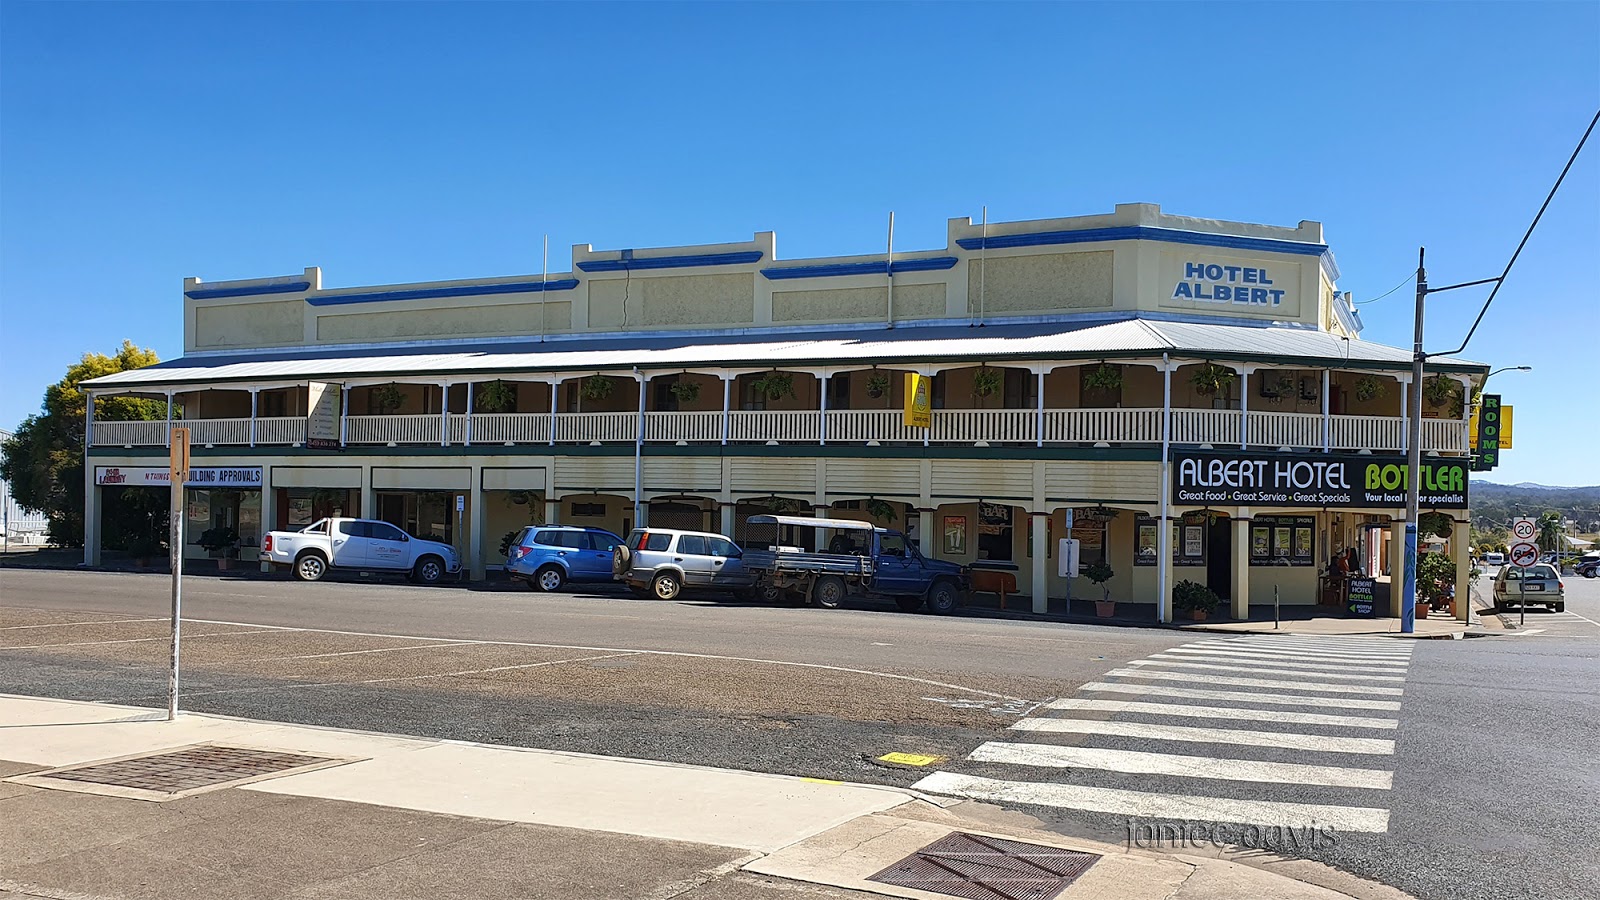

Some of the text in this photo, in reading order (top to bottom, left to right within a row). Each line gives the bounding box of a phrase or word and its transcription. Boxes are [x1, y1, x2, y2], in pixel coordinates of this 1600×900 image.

[1184, 262, 1273, 286] HOTEL
[1171, 281, 1285, 307] ALBERT
[1483, 398, 1498, 464] ROOMS
[188, 470, 261, 482] UILDING APPROVALS
[1179, 458, 1351, 489] ALBERT HOTEL
[1179, 490, 1351, 504] Great Food Great Service Great Specials
[1365, 492, 1382, 502] Your
[1384, 493, 1402, 503] local
[1428, 494, 1464, 505] specialist
[983, 505, 1008, 520] BAR
[1517, 525, 1532, 535] 20
